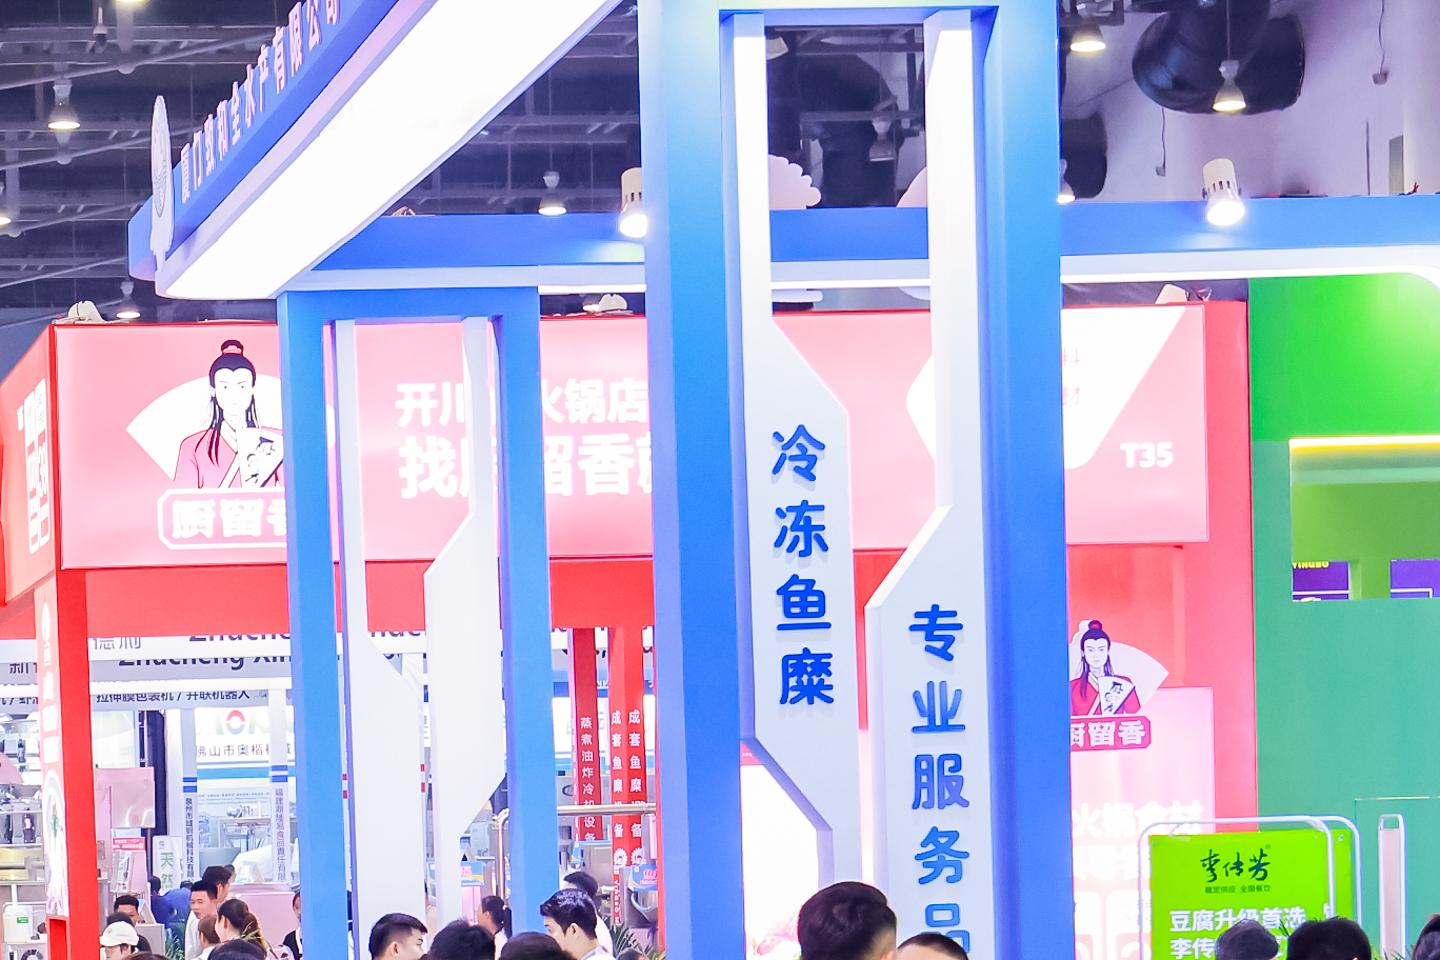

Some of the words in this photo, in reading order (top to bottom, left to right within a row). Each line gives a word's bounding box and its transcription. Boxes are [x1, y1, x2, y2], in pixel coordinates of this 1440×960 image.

[1120, 442, 1174, 469] T35
[771, 424, 834, 706] 冷冻鱼糜
